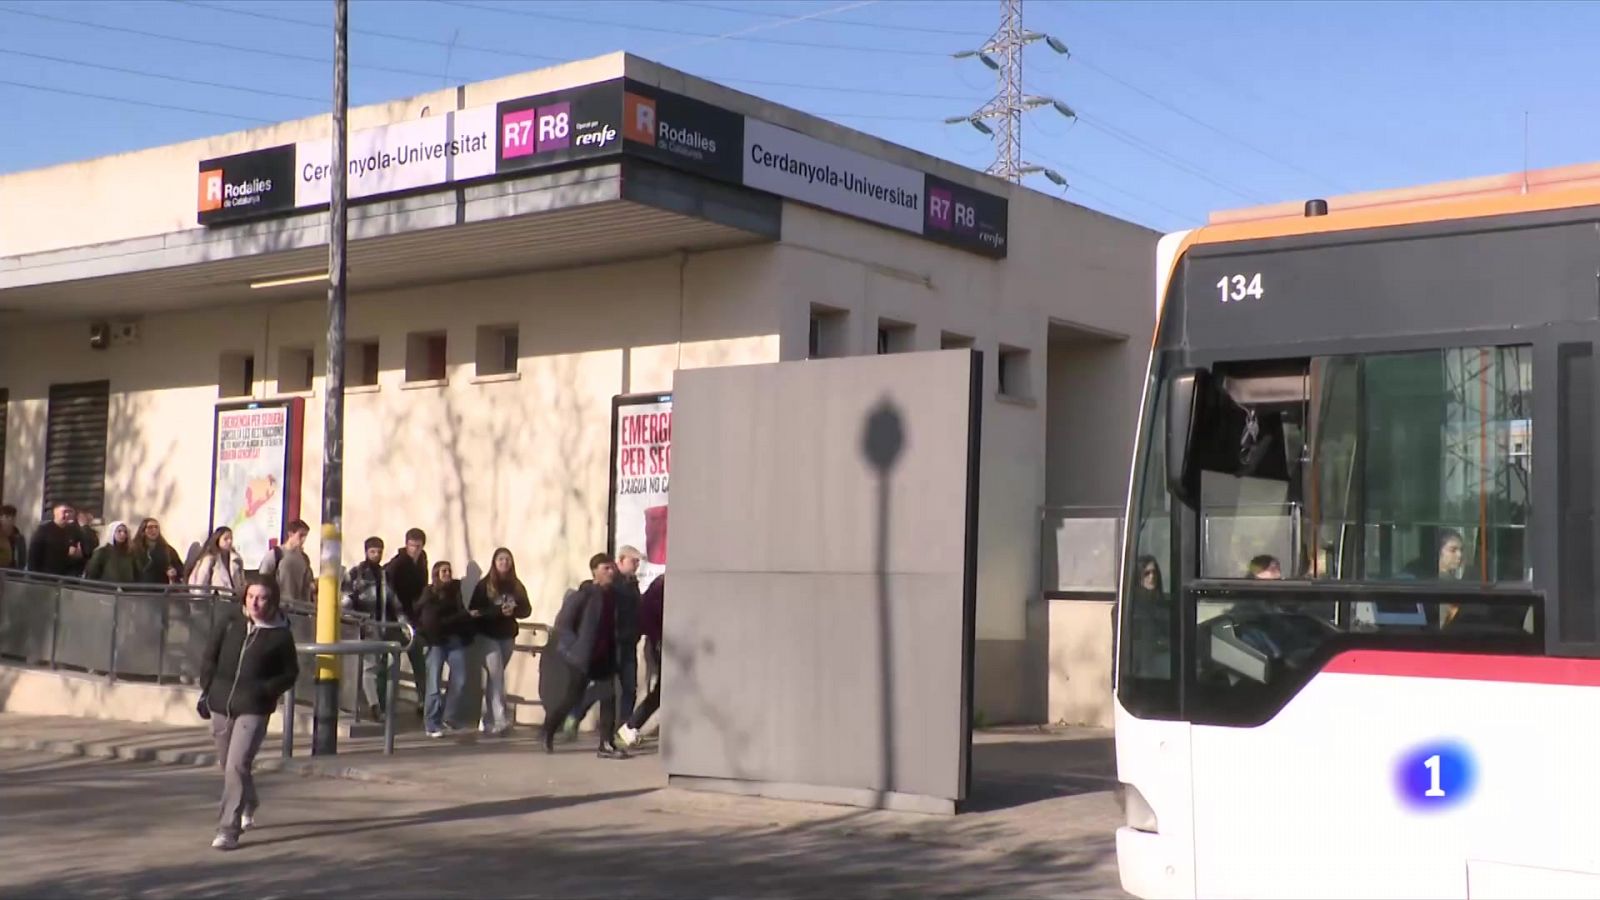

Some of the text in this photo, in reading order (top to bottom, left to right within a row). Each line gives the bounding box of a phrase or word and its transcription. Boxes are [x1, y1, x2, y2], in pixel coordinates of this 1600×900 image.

[504, 112, 569, 148] R7 R8
[636, 103, 654, 134] R
[576, 124, 616, 147] renfe
[659, 121, 716, 153] Rodalies
[303, 131, 488, 183] Cernyola-Universitat
[207, 176, 220, 201] R
[224, 178, 272, 198] Rodalies
[751, 144, 918, 211] Cerdanyola-Universitat
[930, 196, 951, 220] R7
[955, 203, 975, 228] R8
[1216, 272, 1264, 302] 134
[621, 447, 646, 476] PER
[648, 477, 660, 494] NO
